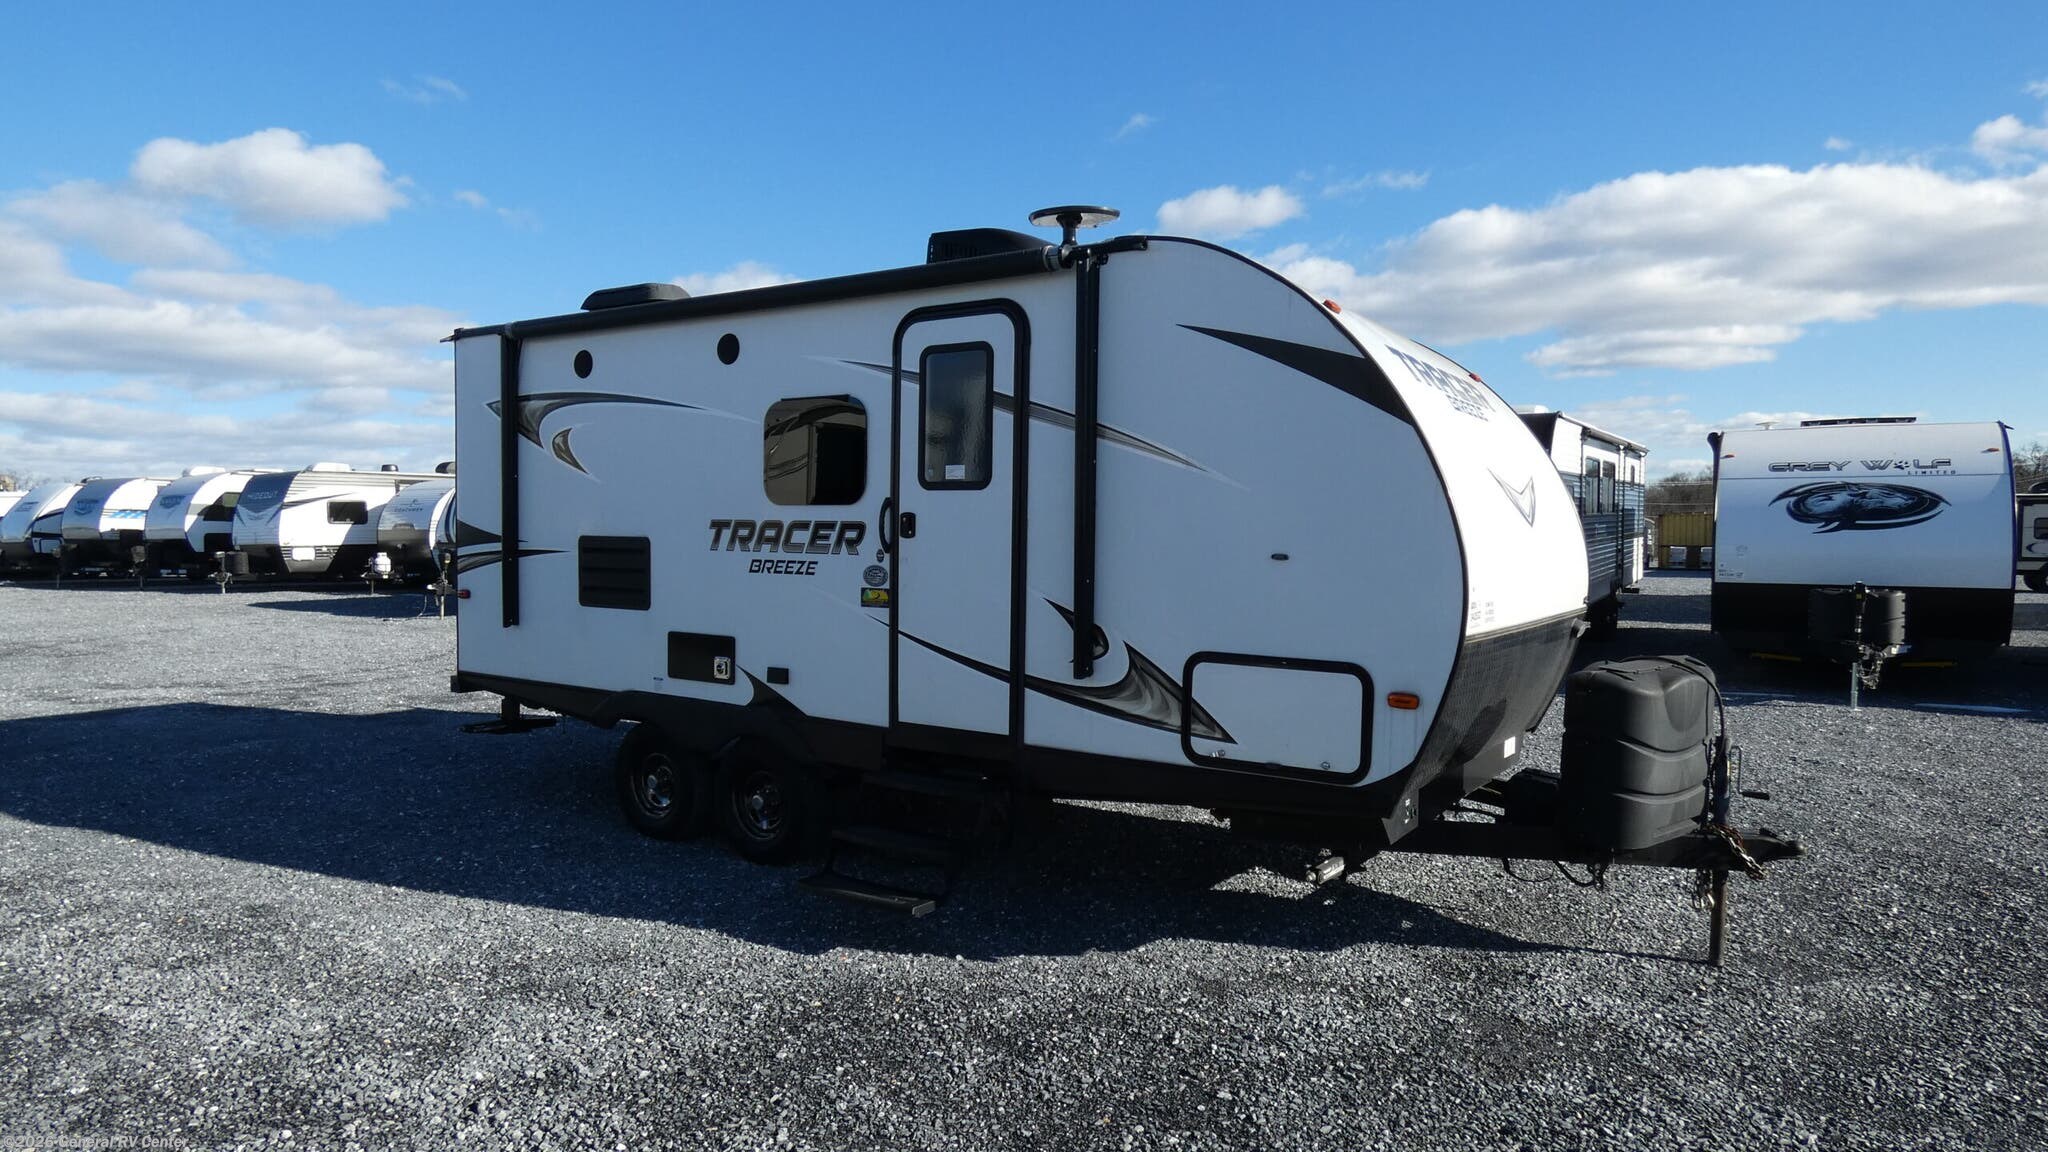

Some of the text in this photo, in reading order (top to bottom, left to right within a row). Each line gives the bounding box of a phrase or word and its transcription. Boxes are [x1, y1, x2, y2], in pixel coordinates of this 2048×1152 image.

[1384, 343, 1496, 413] TRACER
[1767, 460, 1852, 473] GREY
[708, 519, 867, 556] TRACER
[748, 558, 818, 576] BREEZE
